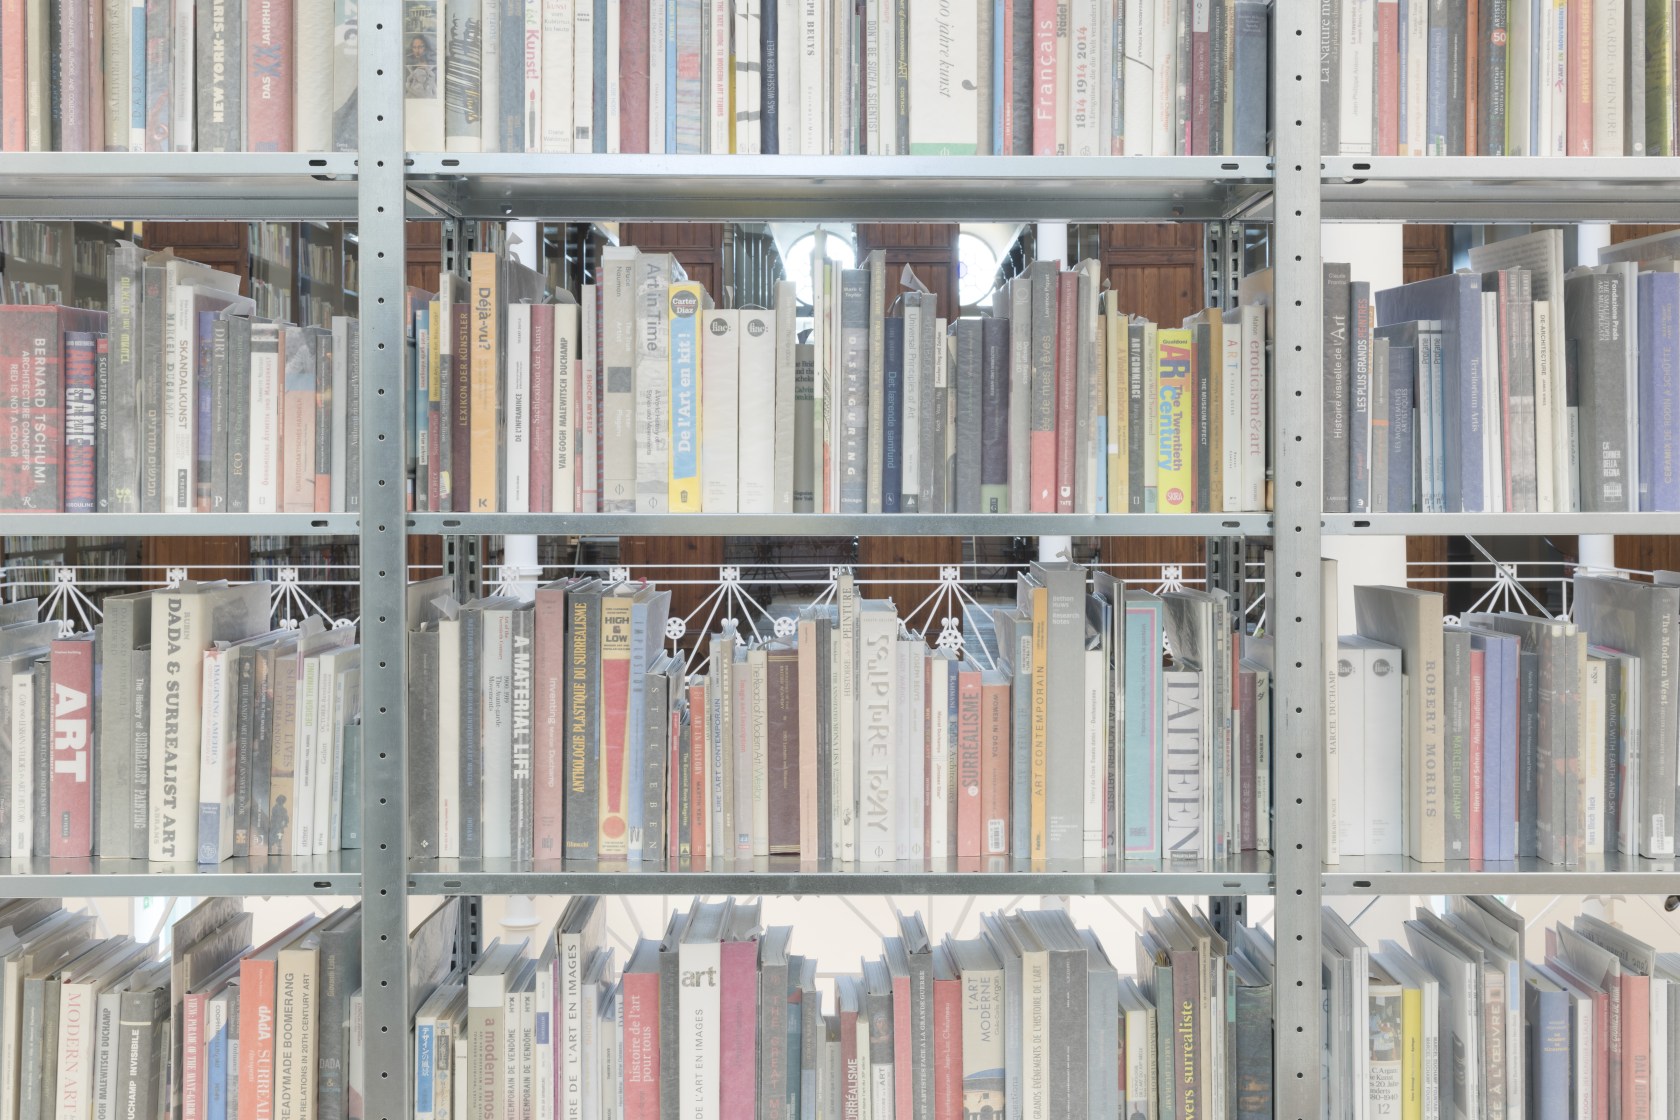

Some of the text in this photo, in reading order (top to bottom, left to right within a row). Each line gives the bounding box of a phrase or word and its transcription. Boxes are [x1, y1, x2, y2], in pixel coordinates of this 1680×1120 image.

[716, 2, 724, 12] THE
[716, 14, 724, 27] TATE
[716, 29, 724, 46] GUIDE
[806, 21, 814, 56] BEUYS
[868, 20, 878, 44] DON'T
[526, 8, 538, 80] ist Kunst!
[716, 58, 724, 82] MODERN
[766, 40, 775, 114] DAS WISSEN DER WELT
[868, 47, 878, 58] BE
[868, 61, 878, 82] SUCH
[935, 18, 955, 98] jahre kunst
[1038, 20, 1054, 120] Français
[1076, 26, 1086, 128] 1814 1914 2014
[1320, 19, 1330, 84] La Nature
[111, 60, 120, 122] PRIMITIVES
[214, 87, 224, 122] NEW
[716, 84, 724, 94] ART
[716, 97, 724, 117] TERMS
[868, 93, 878, 134] SCIENTIST
[1607, 77, 1617, 138] PEINTURE
[477, 287, 492, 351] Déjà-vu?
[646, 263, 661, 351] Art in Time
[214, 328, 225, 360] DIRT
[460, 313, 469, 426] LEXIKON DER KÜNSTLER
[678, 369, 691, 387] en
[907, 313, 917, 419] Universal Principles of Art
[1356, 298, 1366, 412] LES PLUS GRANDS PEINTRES
[34, 338, 46, 484] BERNARD TSCHUMI
[179, 340, 188, 429] SKANDALKUNST
[558, 337, 568, 469] VAN GOGH MALEWITSCH DUCHAMP
[678, 391, 691, 426] l'Art
[847, 336, 856, 476] DISFIGURING
[887, 371, 897, 468] Det lærende samfund
[1249, 340, 1262, 456] eroticism&art
[233, 453, 243, 475] ECO
[678, 431, 691, 452] De
[1158, 385, 1178, 471] Century
[1173, 385, 1183, 471] The Twentieth
[605, 616, 630, 624] HIGH
[633, 621, 643, 693] IMPLOSION
[1660, 613, 1670, 706] The Modern West
[162, 598, 180, 857] DADA & SURREALIST ART
[283, 668, 295, 768] SURREAL LIVES
[305, 663, 314, 726] DESIGN THINKING
[514, 635, 530, 780] A MATERIAL LIFE
[548, 677, 558, 724] Inventing
[992, 721, 999, 733] IN
[55, 682, 87, 782] ART
[134, 678, 146, 829] The History of SURREALIST PAINTING
[694, 715, 702, 775] ART IN HISTORY
[867, 635, 890, 832] SCULPTURE TODAY
[963, 692, 981, 787] SURRÉALISME
[1036, 667, 1044, 796] ART CONTEMPORAIN
[1167, 671, 1200, 852] TAITEEN
[1426, 660, 1437, 818] ROBERT MORRIS
[649, 687, 658, 849] STILLEBEN
[1452, 735, 1462, 820] MARCEL DUCHAMP
[284, 972, 294, 1048] BOOMERANG
[301, 992, 309, 1032] CENTURY
[302, 973, 310, 990] ART
[682, 967, 717, 987] art
[968, 977, 978, 1010] L'ART
[981, 977, 991, 1042] MODERNE
[992, 976, 1001, 1002] Argan
[64, 993, 82, 1112] MODERN ART
[130, 1029, 139, 1076] INVISIBILE
[258, 1006, 271, 1041] dAdA
[568, 944, 577, 1094] DE L'ART EN IMAGES
[629, 995, 640, 1082] histoire de l'art
[642, 1026, 655, 1082] pour tous
[1178, 1000, 1194, 1084] surréaliste
[300, 1065, 308, 1112] RELATIONS
[695, 1009, 703, 1120] DE L'ART EN IMAGES
[1164, 1038, 1172, 1110] MARCEL DUCHAMP
